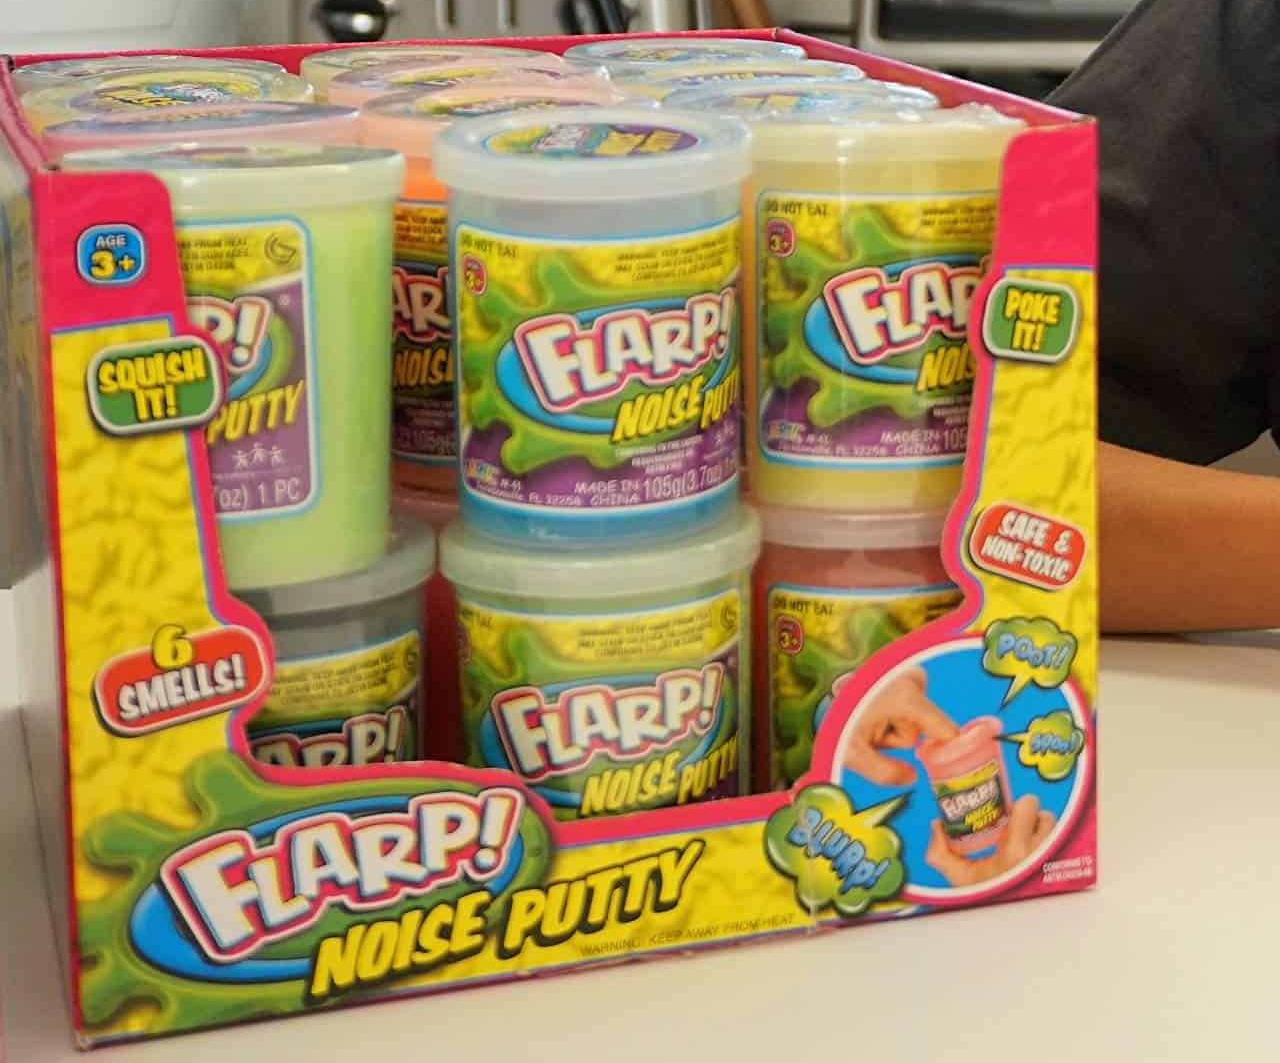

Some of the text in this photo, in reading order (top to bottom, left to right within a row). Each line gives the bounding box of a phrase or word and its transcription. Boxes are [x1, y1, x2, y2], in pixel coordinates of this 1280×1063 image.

[89, 248, 135, 278] 3+
[96, 234, 127, 248] AGE
[1004, 287, 1062, 324] POKE
[522, 290, 734, 404] FLARP!
[1011, 320, 1044, 352] IT!
[98, 347, 206, 393] SQUISH
[132, 383, 179, 423] IT!
[206, 379, 305, 446] PUTTY
[610, 374, 706, 443] NOISE
[275, 478, 300, 506] PC
[999, 510, 1074, 555] SAFE &
[980, 535, 1074, 582] NON-TOXIC
[152, 624, 194, 670] 6
[118, 653, 248, 722] SMELLS!
[500, 666, 720, 774] FLARP!
[580, 751, 681, 816] NOISE
[172, 789, 516, 956] FLARP!
[787, 805, 890, 896] BLURP!
[309, 838, 705, 998] NOISE PUTTY
